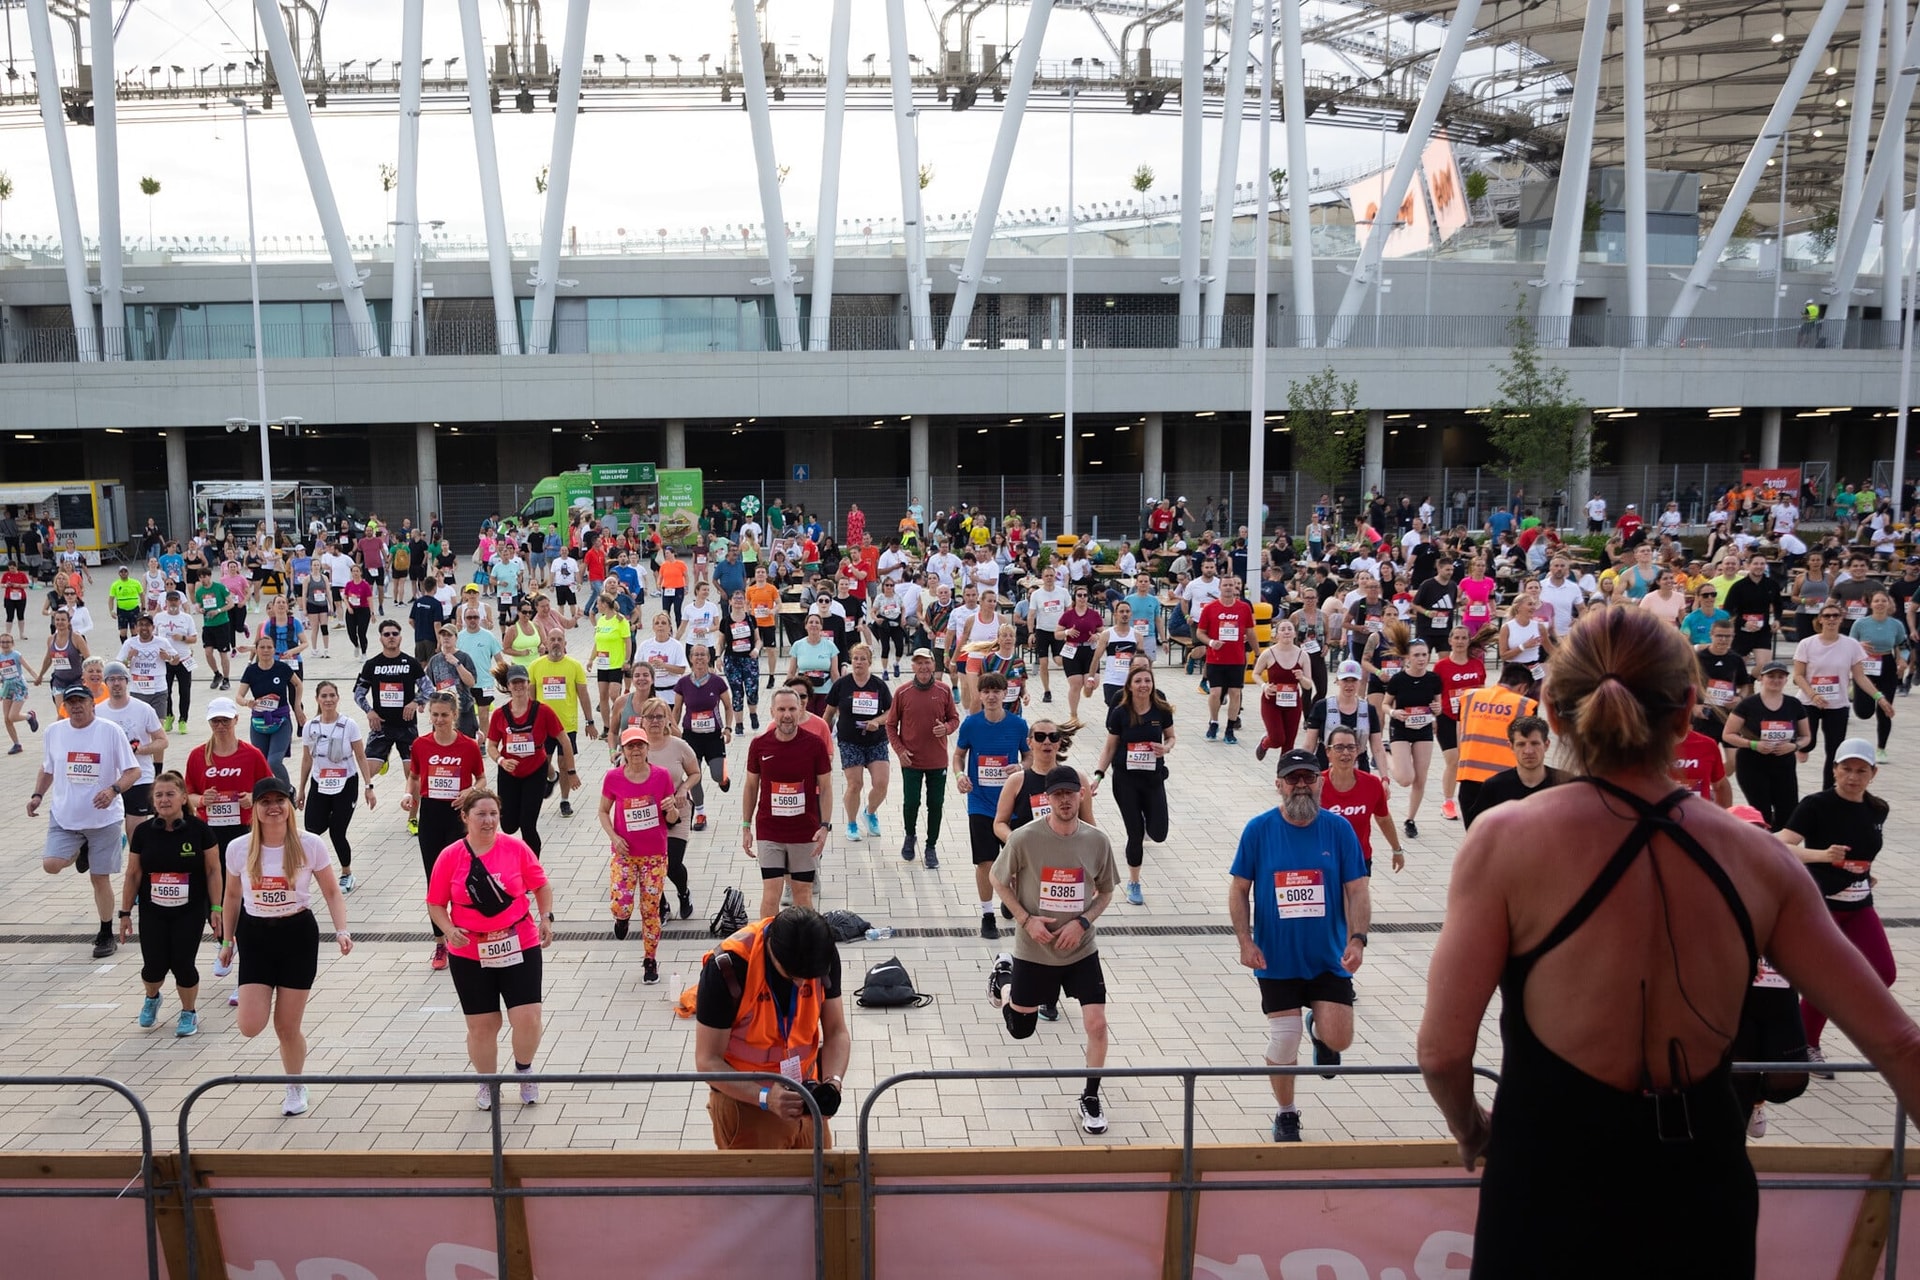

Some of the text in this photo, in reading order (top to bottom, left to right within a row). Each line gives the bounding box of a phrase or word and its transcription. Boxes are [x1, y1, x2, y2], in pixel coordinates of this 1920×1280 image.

[374, 664, 410, 675] BOXING
[1134, 753, 1150, 761] 5721
[74, 764, 92, 773] 6002
[434, 778, 452, 788] 5852
[778, 796, 798, 805] 5690
[212, 804, 232, 814] 5853
[632, 808, 650, 819] 5816
[158, 886, 180, 896] 5656
[262, 890, 286, 902] 5526
[1050, 885, 1075, 898] 6385
[1286, 888, 1314, 902] 6082
[488, 941, 512, 956] 5040
